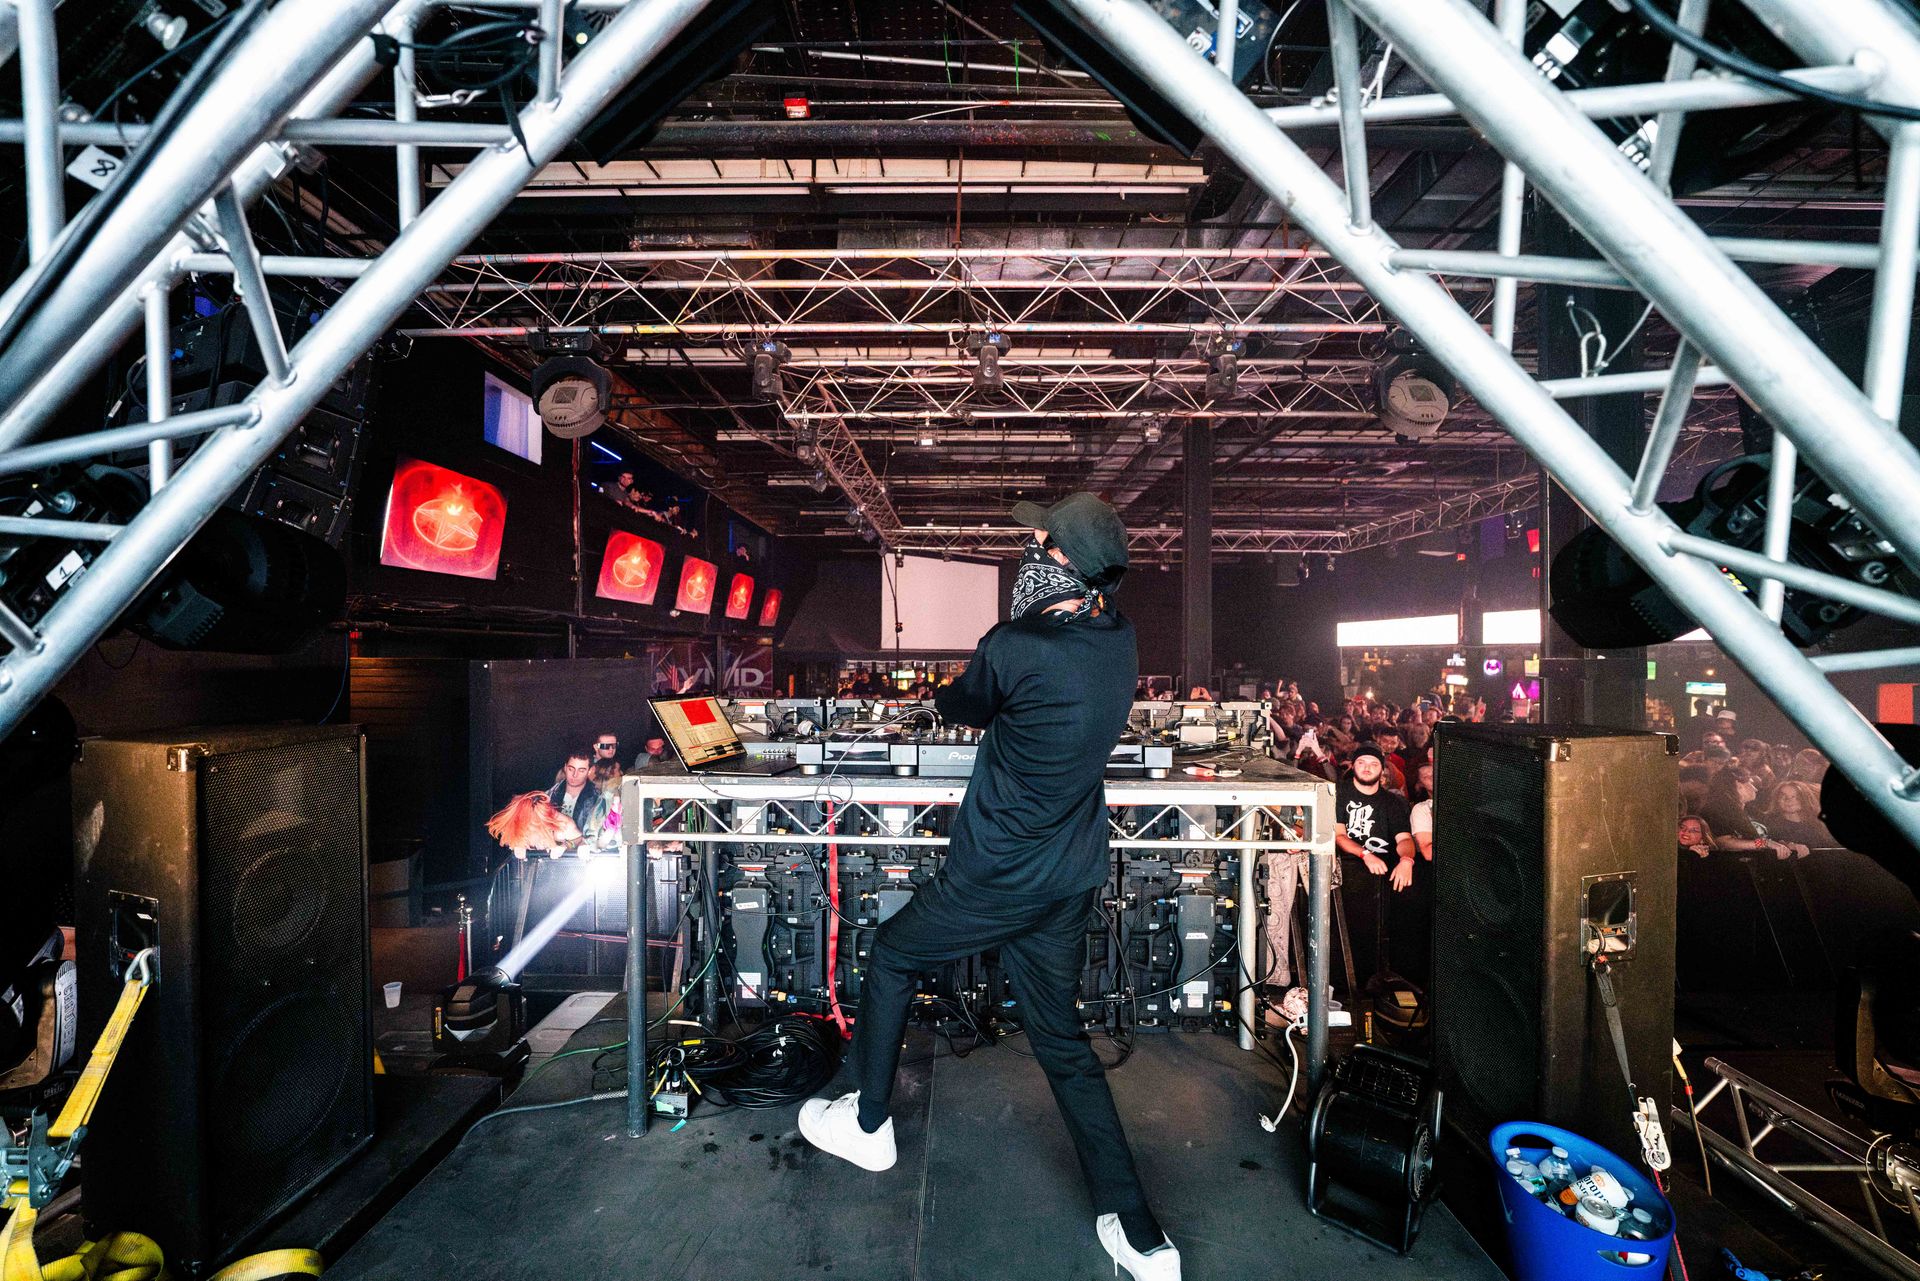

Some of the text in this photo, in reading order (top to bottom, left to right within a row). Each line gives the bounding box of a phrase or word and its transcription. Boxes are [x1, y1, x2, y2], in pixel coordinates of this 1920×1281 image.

[59, 566, 73, 580] 1
[948, 751, 977, 760] Pion
[1582, 1175, 1610, 1204] oron
